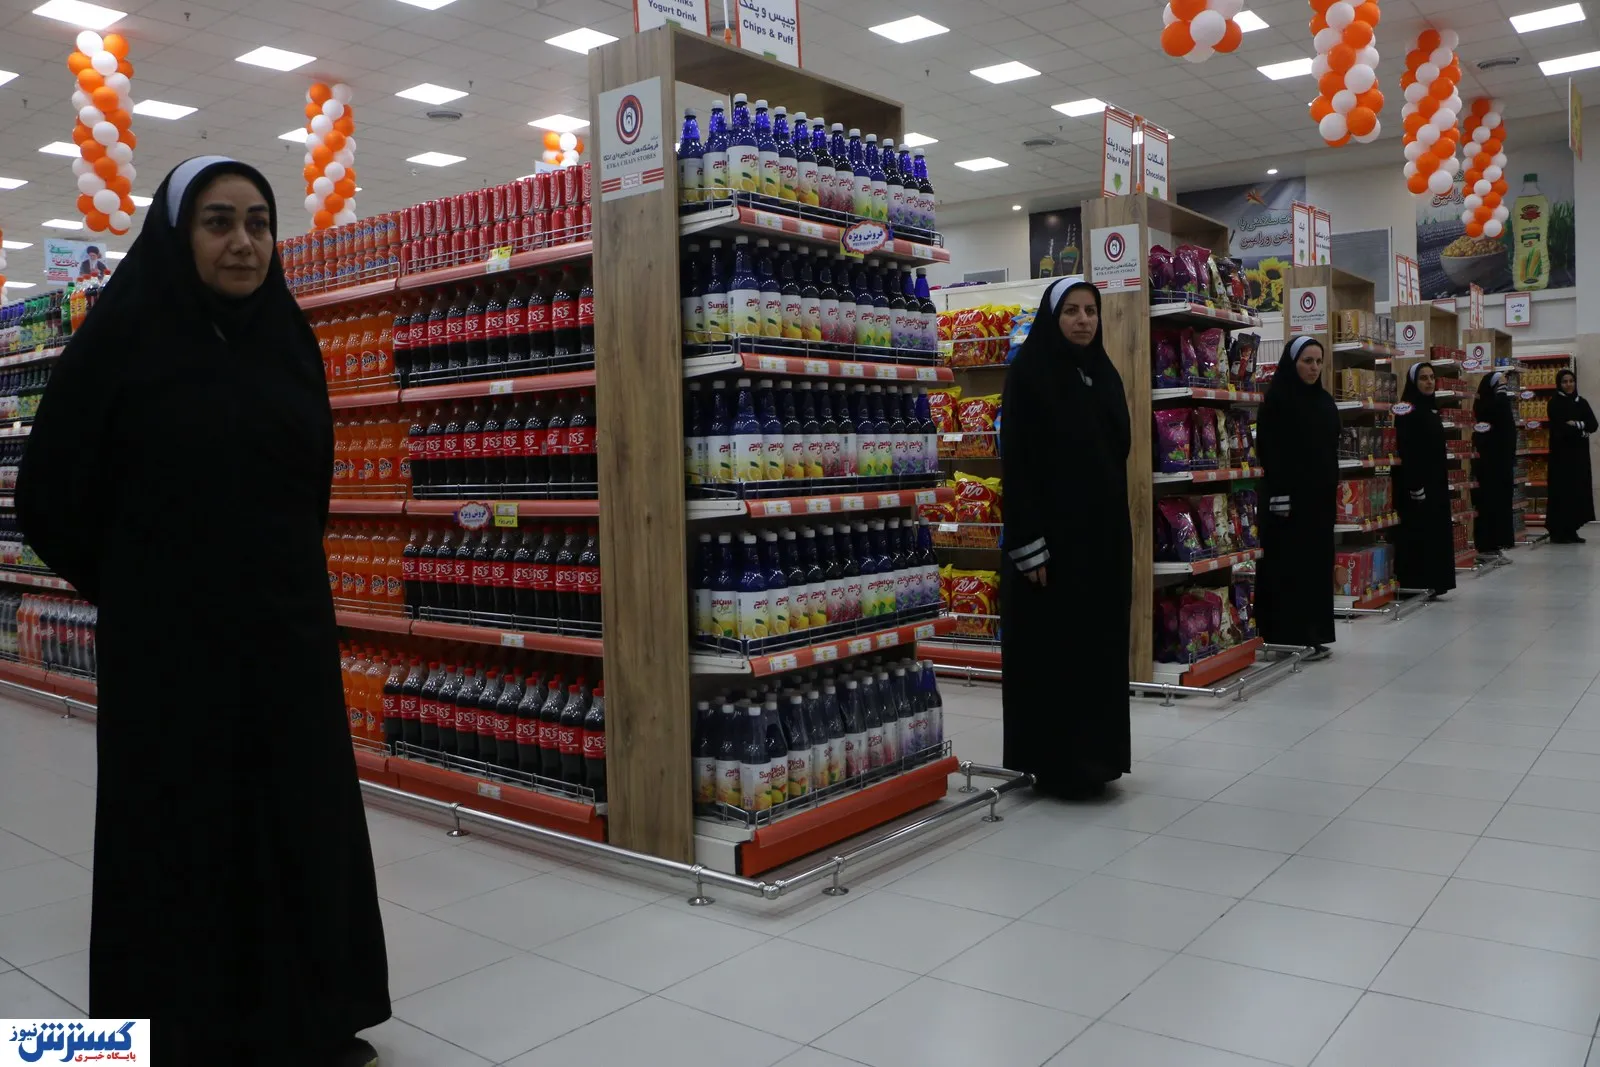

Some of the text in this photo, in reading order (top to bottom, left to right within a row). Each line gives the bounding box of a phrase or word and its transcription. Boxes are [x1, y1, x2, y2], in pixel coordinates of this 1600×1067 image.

[648, 0, 698, 22] Yogurt Drink
[761, 8, 767, 18] و
[768, 13, 796, 31] چیپس
[743, 19, 794, 45] Chips & Puff
[606, 153, 657, 170] ETKA CHAIN STORES
[1107, 153, 1118, 163] Chips
[1146, 169, 1166, 182] Chocolate
[848, 229, 885, 242] فروش ویژه
[707, 300, 729, 310] Sunic
